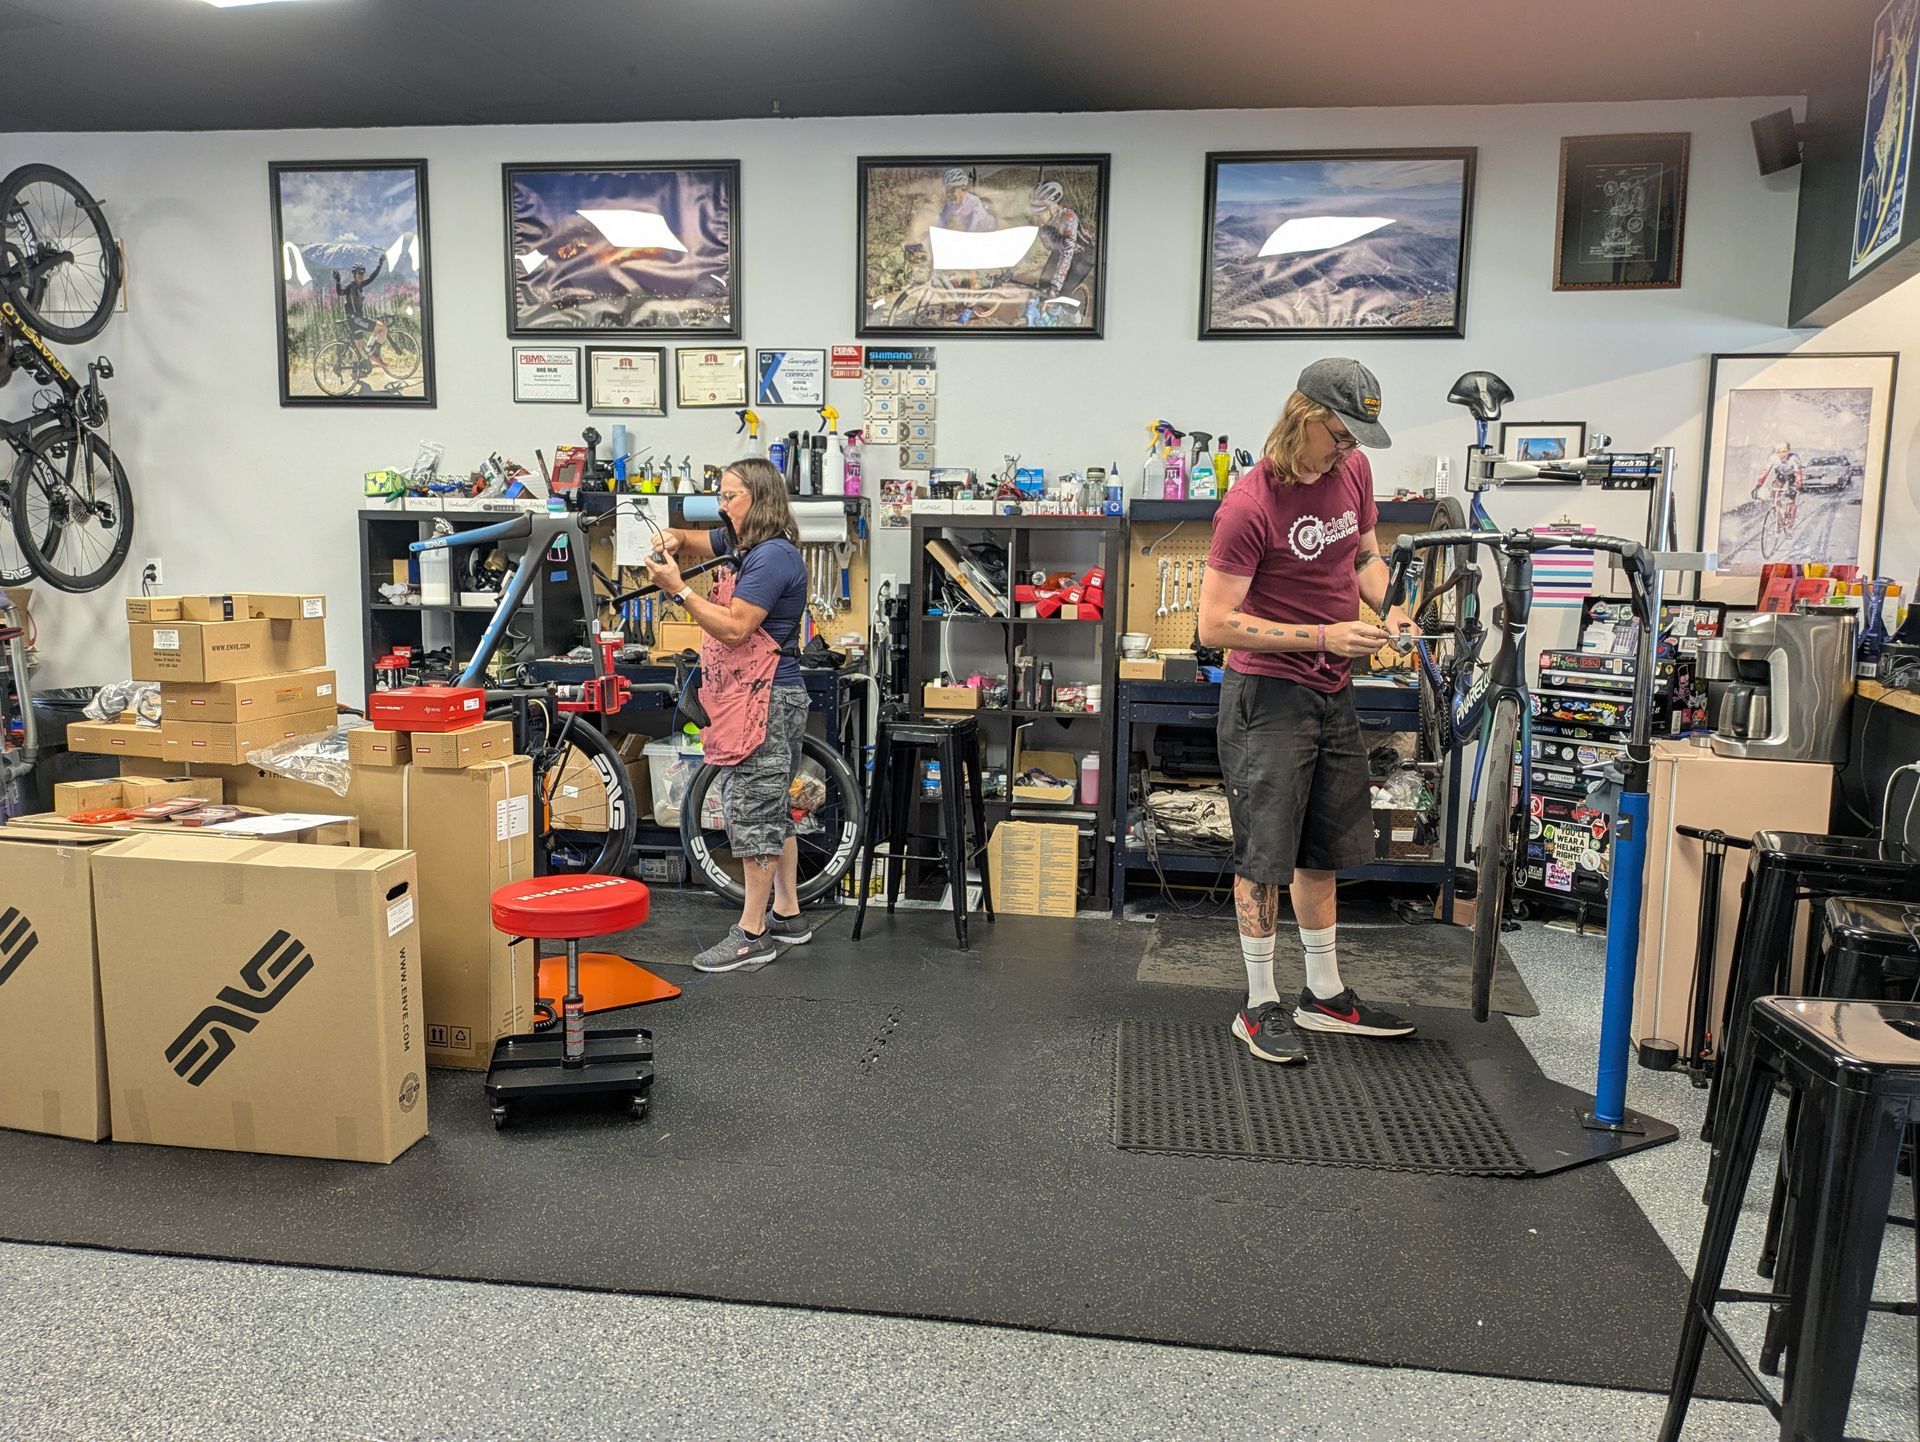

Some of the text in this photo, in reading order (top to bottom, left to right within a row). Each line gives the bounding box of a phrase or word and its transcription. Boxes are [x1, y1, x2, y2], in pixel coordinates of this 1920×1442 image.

[2, 302, 70, 381] PINARELLO
[869, 351, 914, 360] SHIMANO
[211, 643, 251, 652] WWW.ENVE.COM
[1561, 828, 1586, 838] YOU'LL
[1557, 834, 1578, 845] WEAR
[1556, 844, 1585, 853] HELMET
[399, 946, 411, 1053] WWW.ENVE.COM
